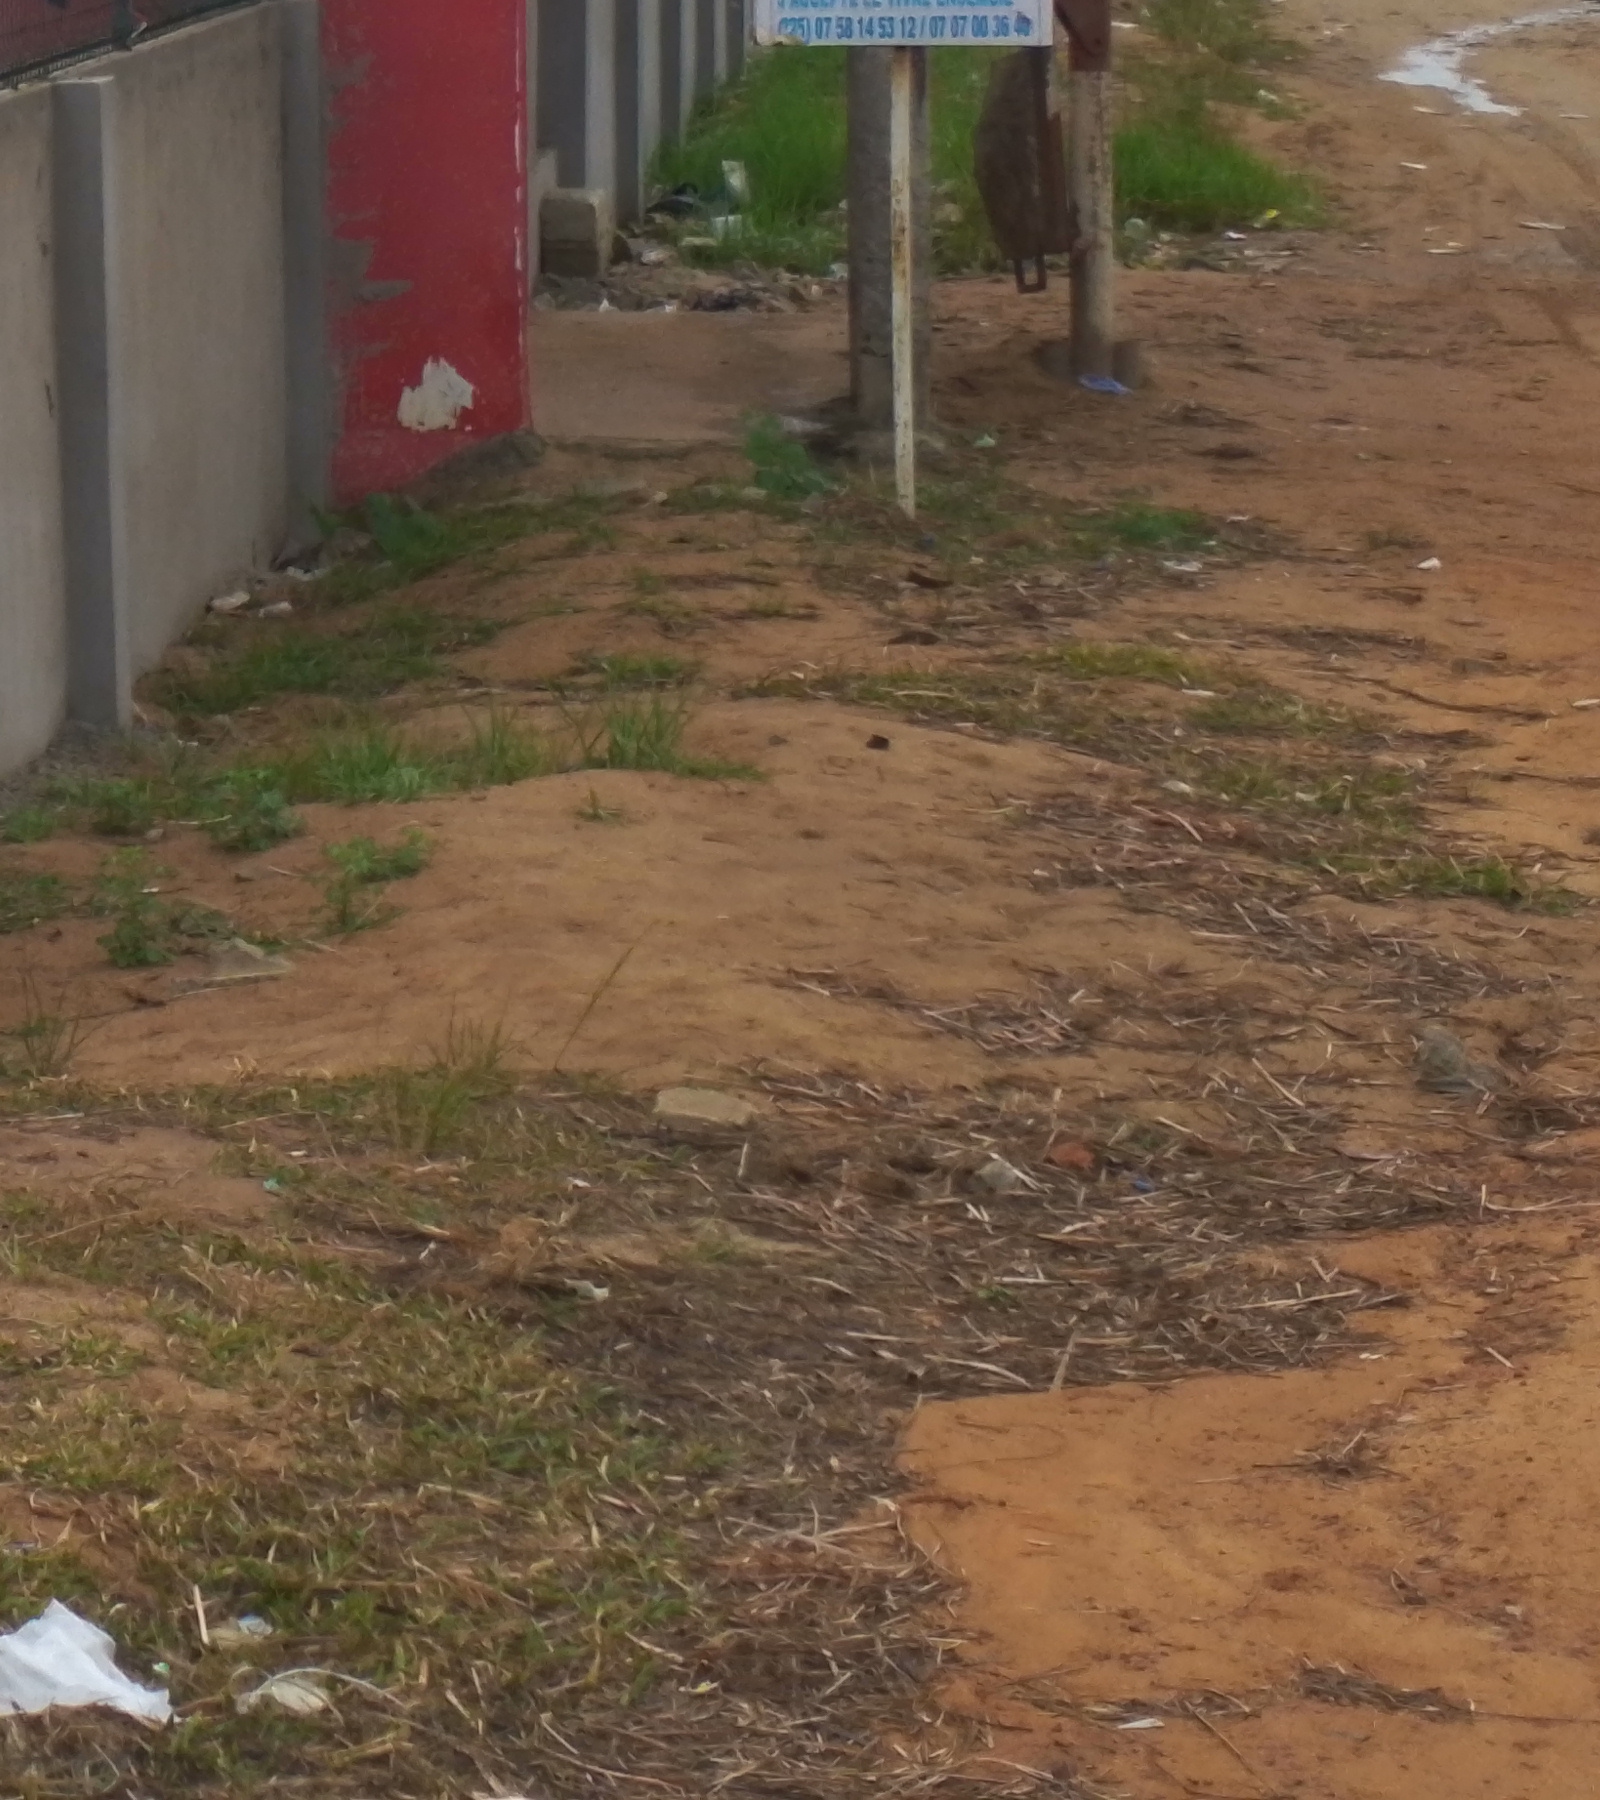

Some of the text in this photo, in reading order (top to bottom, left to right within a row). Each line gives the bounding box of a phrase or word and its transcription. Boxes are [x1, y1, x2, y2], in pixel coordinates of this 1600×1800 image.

[815, 16, 832, 39] 07
[857, 16, 874, 39] 14
[900, 16, 917, 39] 12
[929, 15, 946, 38] 07
[950, 15, 967, 38] 07
